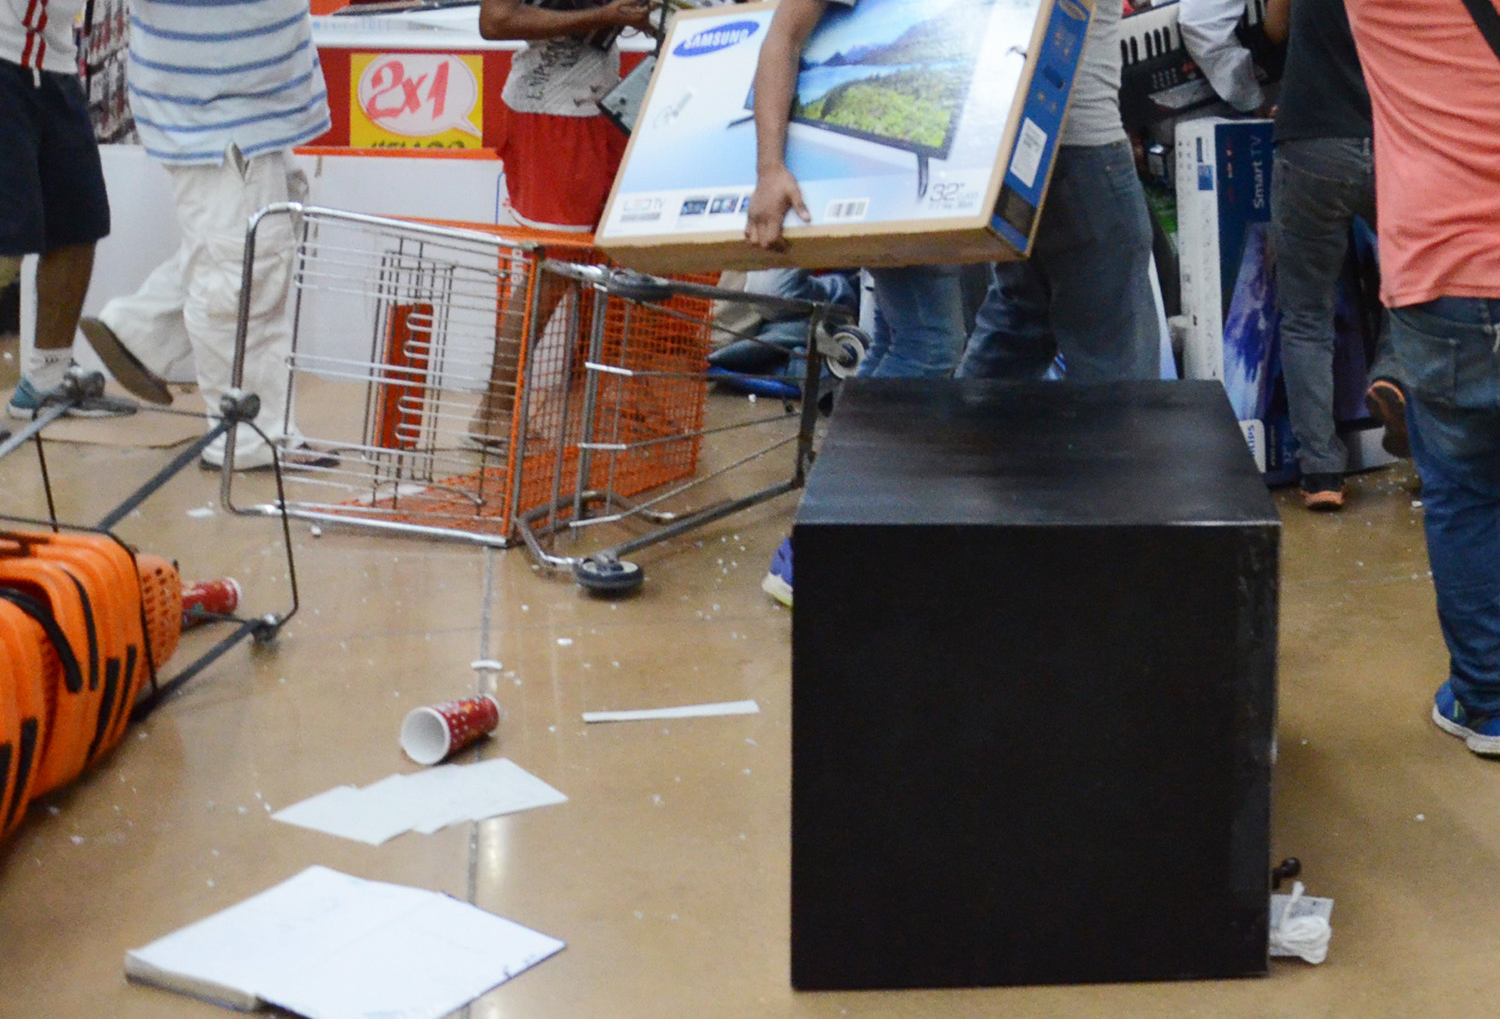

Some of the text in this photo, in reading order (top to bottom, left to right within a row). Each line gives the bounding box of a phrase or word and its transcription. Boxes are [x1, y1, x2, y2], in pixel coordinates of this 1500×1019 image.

[683, 26, 751, 51] SAMSUNG
[366, 60, 449, 121] 2x1
[1251, 136, 1265, 210] Smart TV
